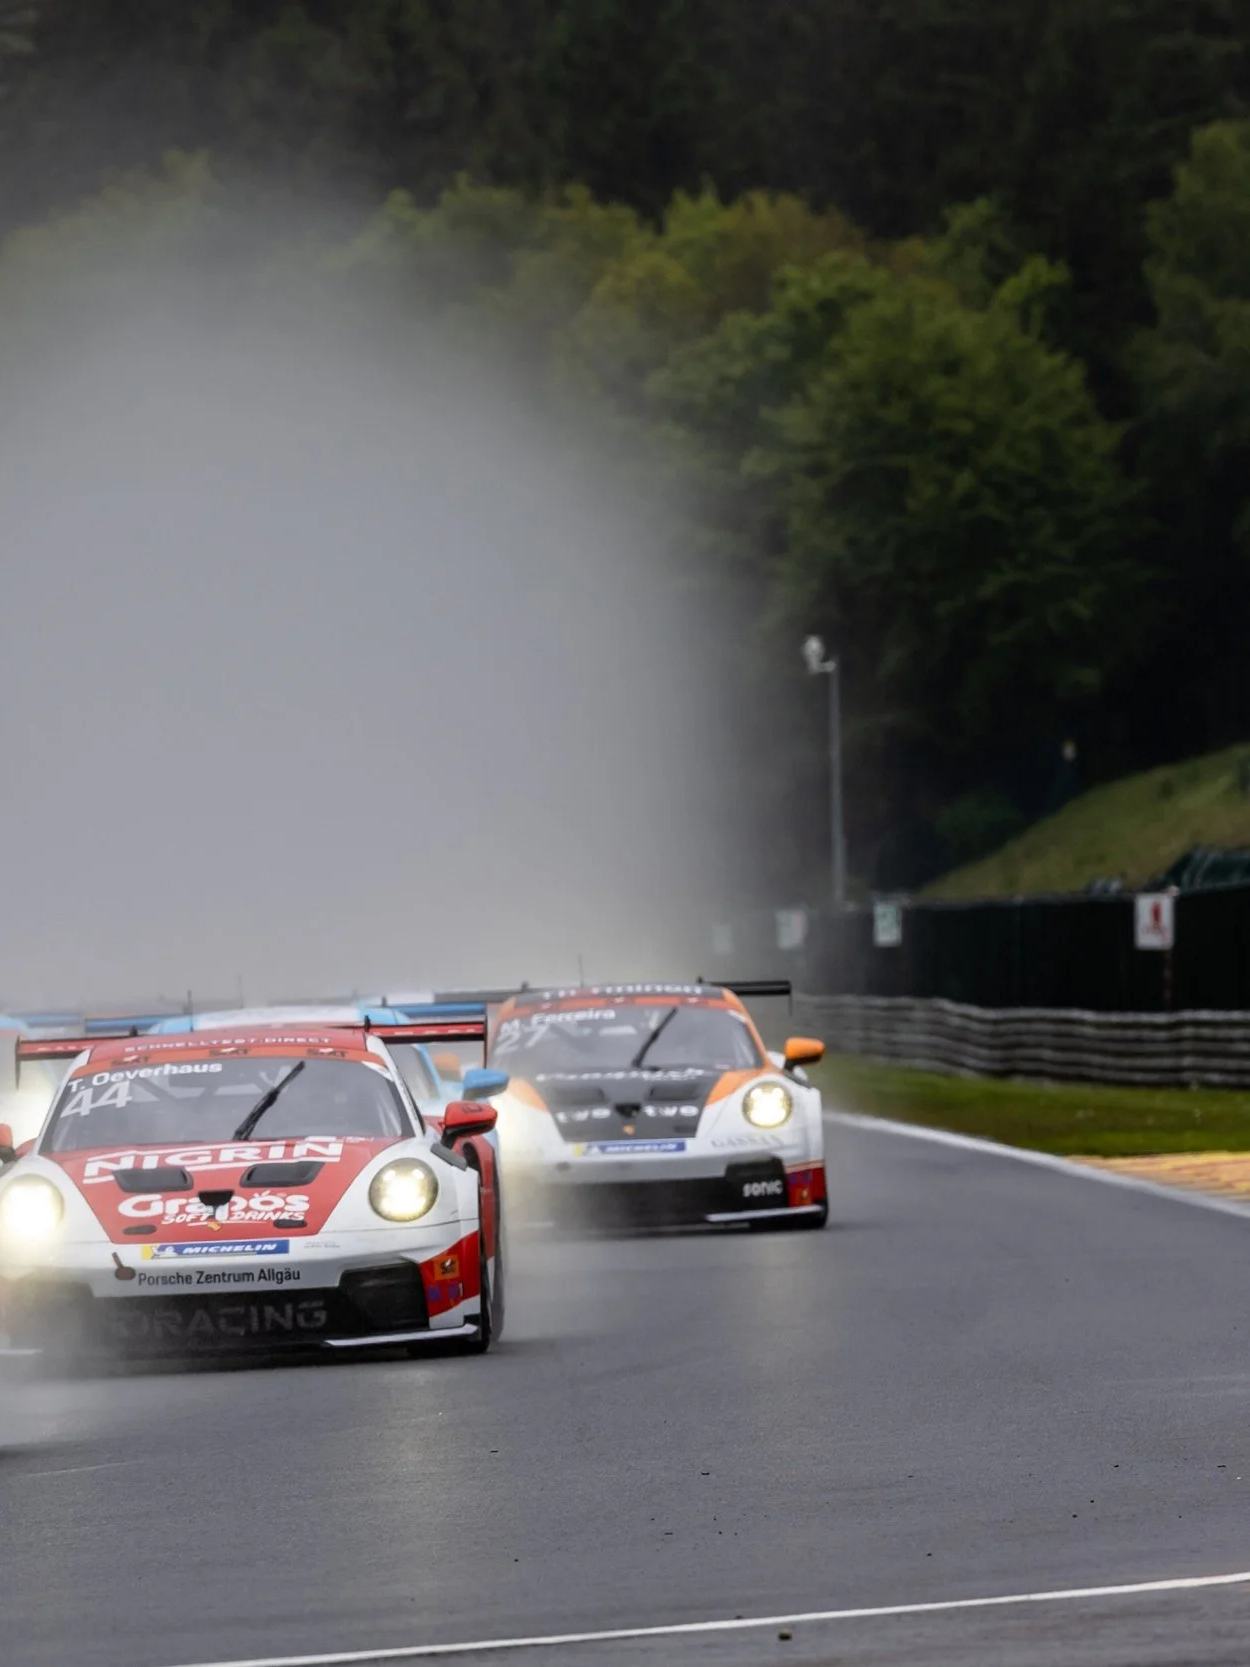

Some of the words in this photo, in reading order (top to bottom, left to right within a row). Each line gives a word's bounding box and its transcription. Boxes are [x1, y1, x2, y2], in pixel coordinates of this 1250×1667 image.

[92, 1062, 223, 1087] Oeverhaus
[60, 1080, 133, 1119] 44
[83, 1139, 344, 1177] NIGRIN
[742, 1179, 784, 1198] sonic
[161, 1212, 214, 1225] SOFT
[231, 1211, 305, 1223] DRINKS
[182, 1242, 278, 1254] MICHELIN
[138, 1271, 193, 1286] Porsche
[195, 1269, 255, 1285] Zentrum
[257, 1267, 301, 1286] Allgäu
